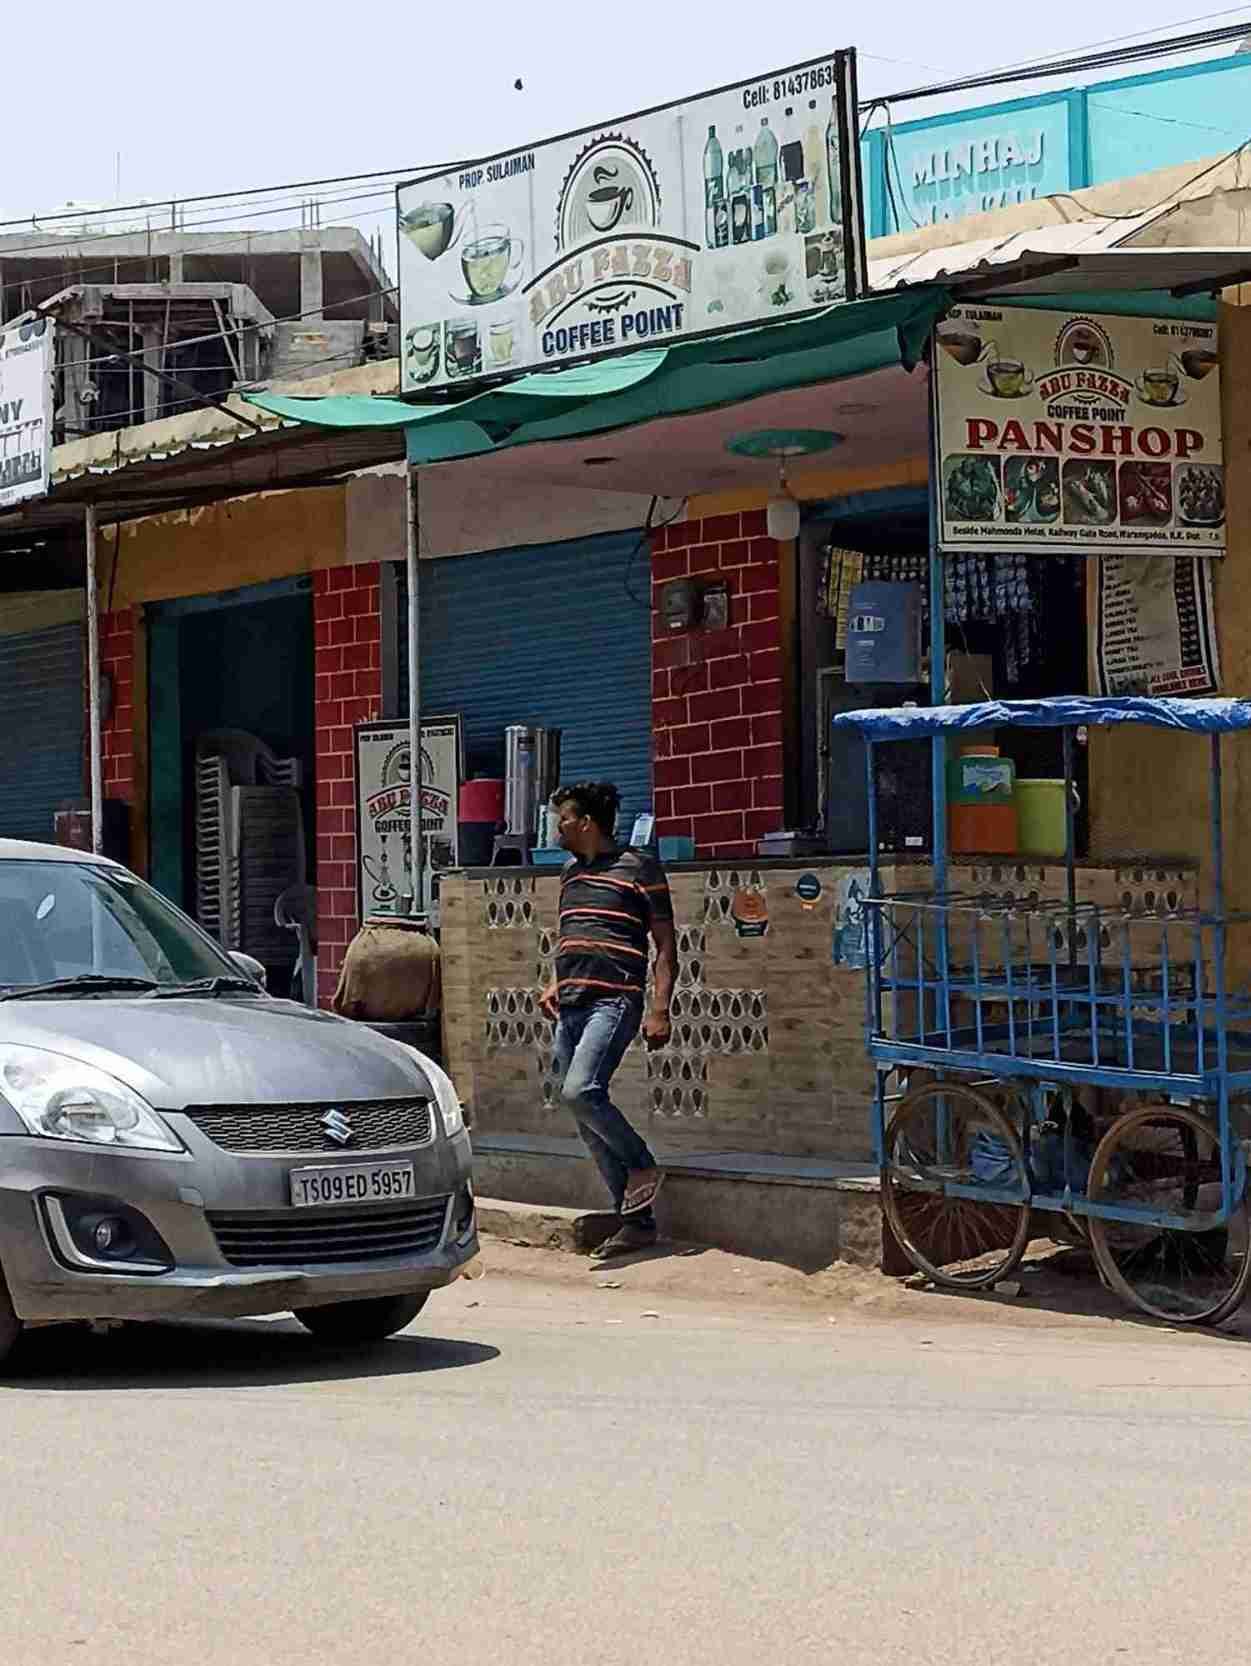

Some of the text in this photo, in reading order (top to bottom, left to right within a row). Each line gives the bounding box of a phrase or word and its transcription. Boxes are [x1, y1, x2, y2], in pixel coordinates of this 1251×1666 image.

[743, 63, 838, 109] Cell: 81437863
[486, 152, 535, 183] SULAIMAN
[913, 131, 1045, 188] MINHAJ
[542, 303, 684, 357] COFFEE POINT
[1039, 373, 1072, 400] ABU
[1047, 405, 1126, 422] COFFEE POINT
[965, 417, 1204, 458] PANSHOP
[301, 1169, 411, 1204] TS09ED 5957
